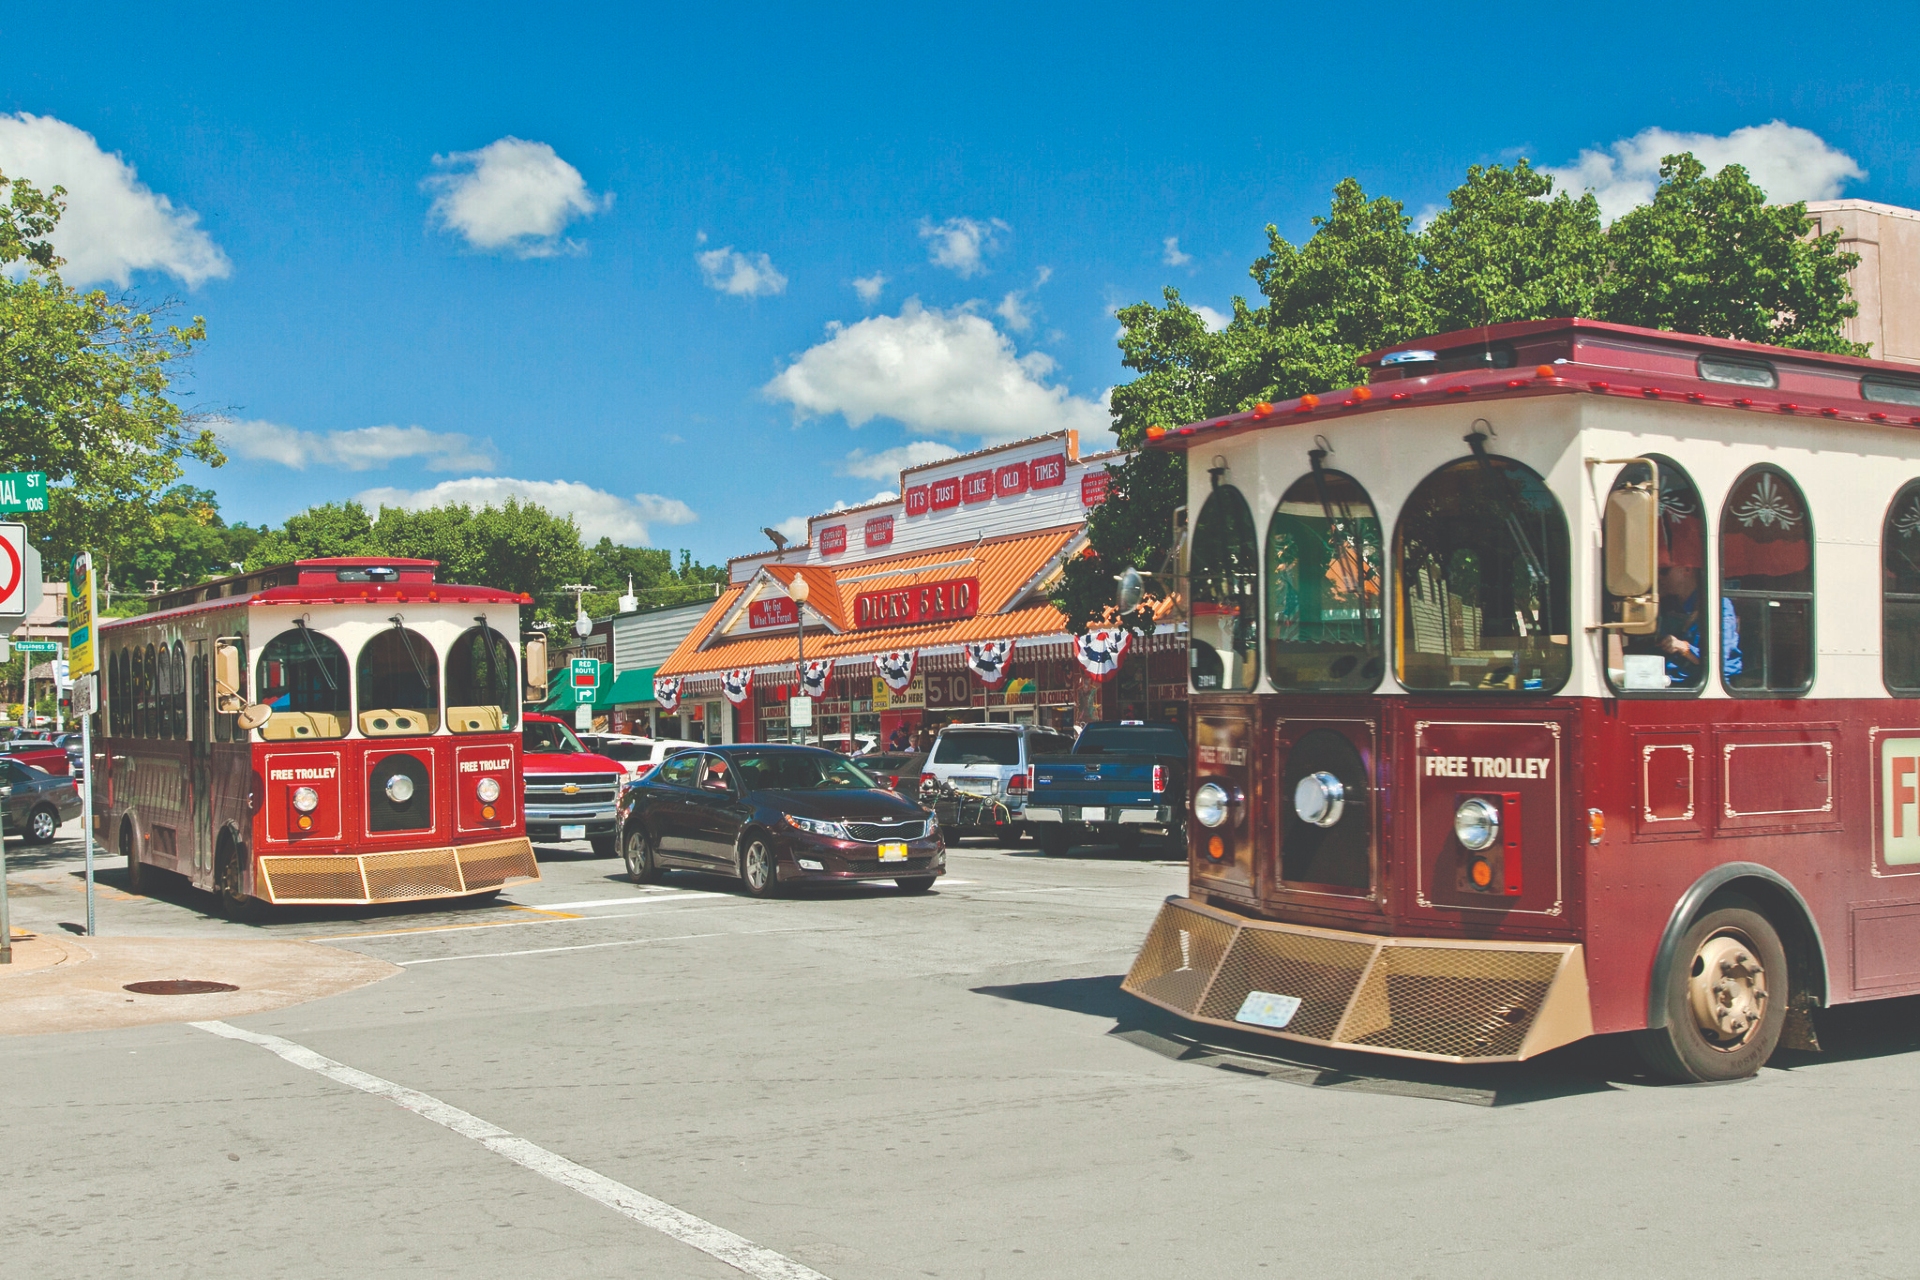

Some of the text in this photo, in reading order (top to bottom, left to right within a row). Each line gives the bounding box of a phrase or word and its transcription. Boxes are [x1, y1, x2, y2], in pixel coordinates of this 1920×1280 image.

[26, 474, 40, 488] ST
[909, 461, 1060, 509] IT'S JUST LIKE OLD TIMES
[25, 497, 44, 511] 100S
[866, 521, 892, 534] HARD TO FIND
[823, 530, 843, 540] SUPER TOY
[872, 532, 886, 541] NEEDS
[821, 538, 845, 550] DEPARTMENT
[71, 594, 87, 618] FREE
[763, 599, 782, 613] We Got
[861, 583, 970, 621] DICK'S 5 & 10
[69, 610, 90, 632] TROLLEY
[753, 611, 792, 626] What You Forgot
[578, 660, 592, 668] RED
[928, 677, 942, 702] 5
[946, 676, 968, 702] 10
[891, 695, 907, 704] SOLD
[908, 693, 923, 703] HERE
[460, 758, 510, 773] FREE TROLLEY
[1425, 756, 1550, 779] FREE TROLLEY
[270, 767, 336, 781] FREE TROLLEY
[1892, 756, 1920, 838] F
